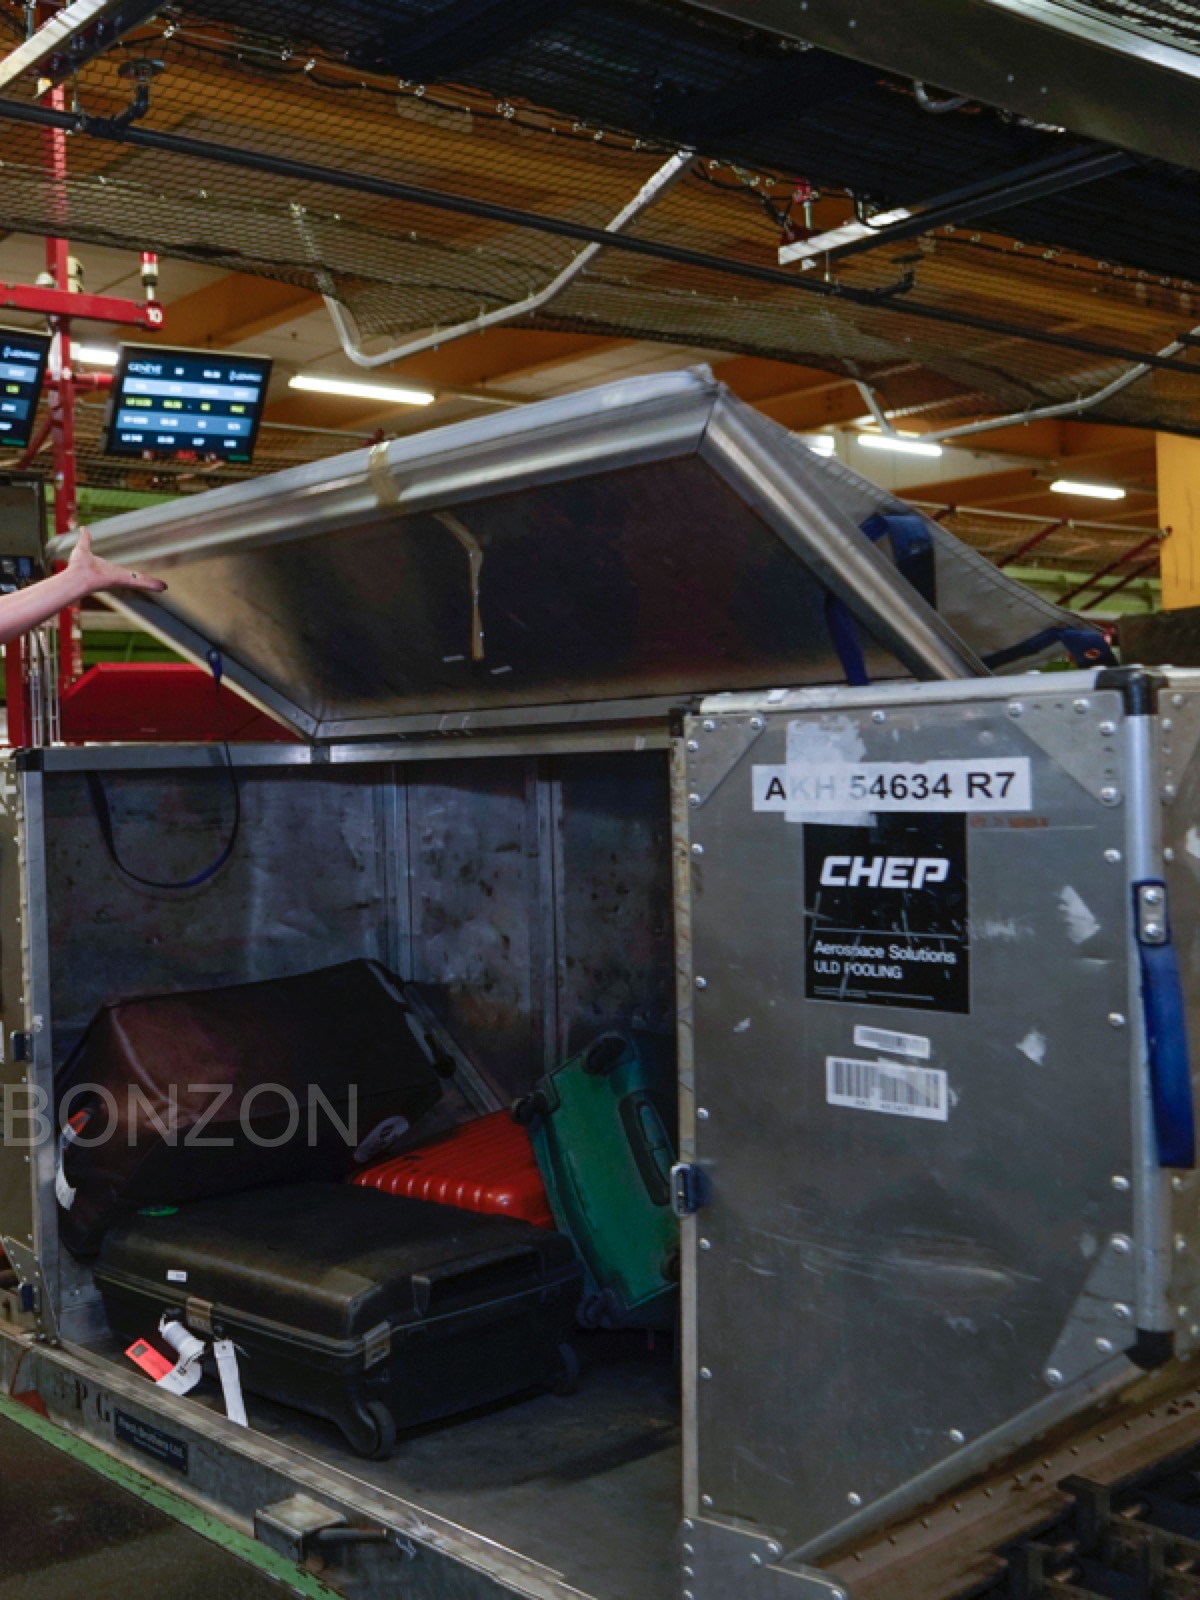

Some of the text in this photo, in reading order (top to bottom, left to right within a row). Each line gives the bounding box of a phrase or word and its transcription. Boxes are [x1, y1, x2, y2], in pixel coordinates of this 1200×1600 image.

[146, 307, 163, 324] 10
[849, 773, 952, 801] 54634
[966, 771, 1016, 799] R7
[818, 855, 950, 890] CHEP
[813, 940, 958, 965] Aerospace Solutions
[813, 959, 903, 979] ULD POOLING
